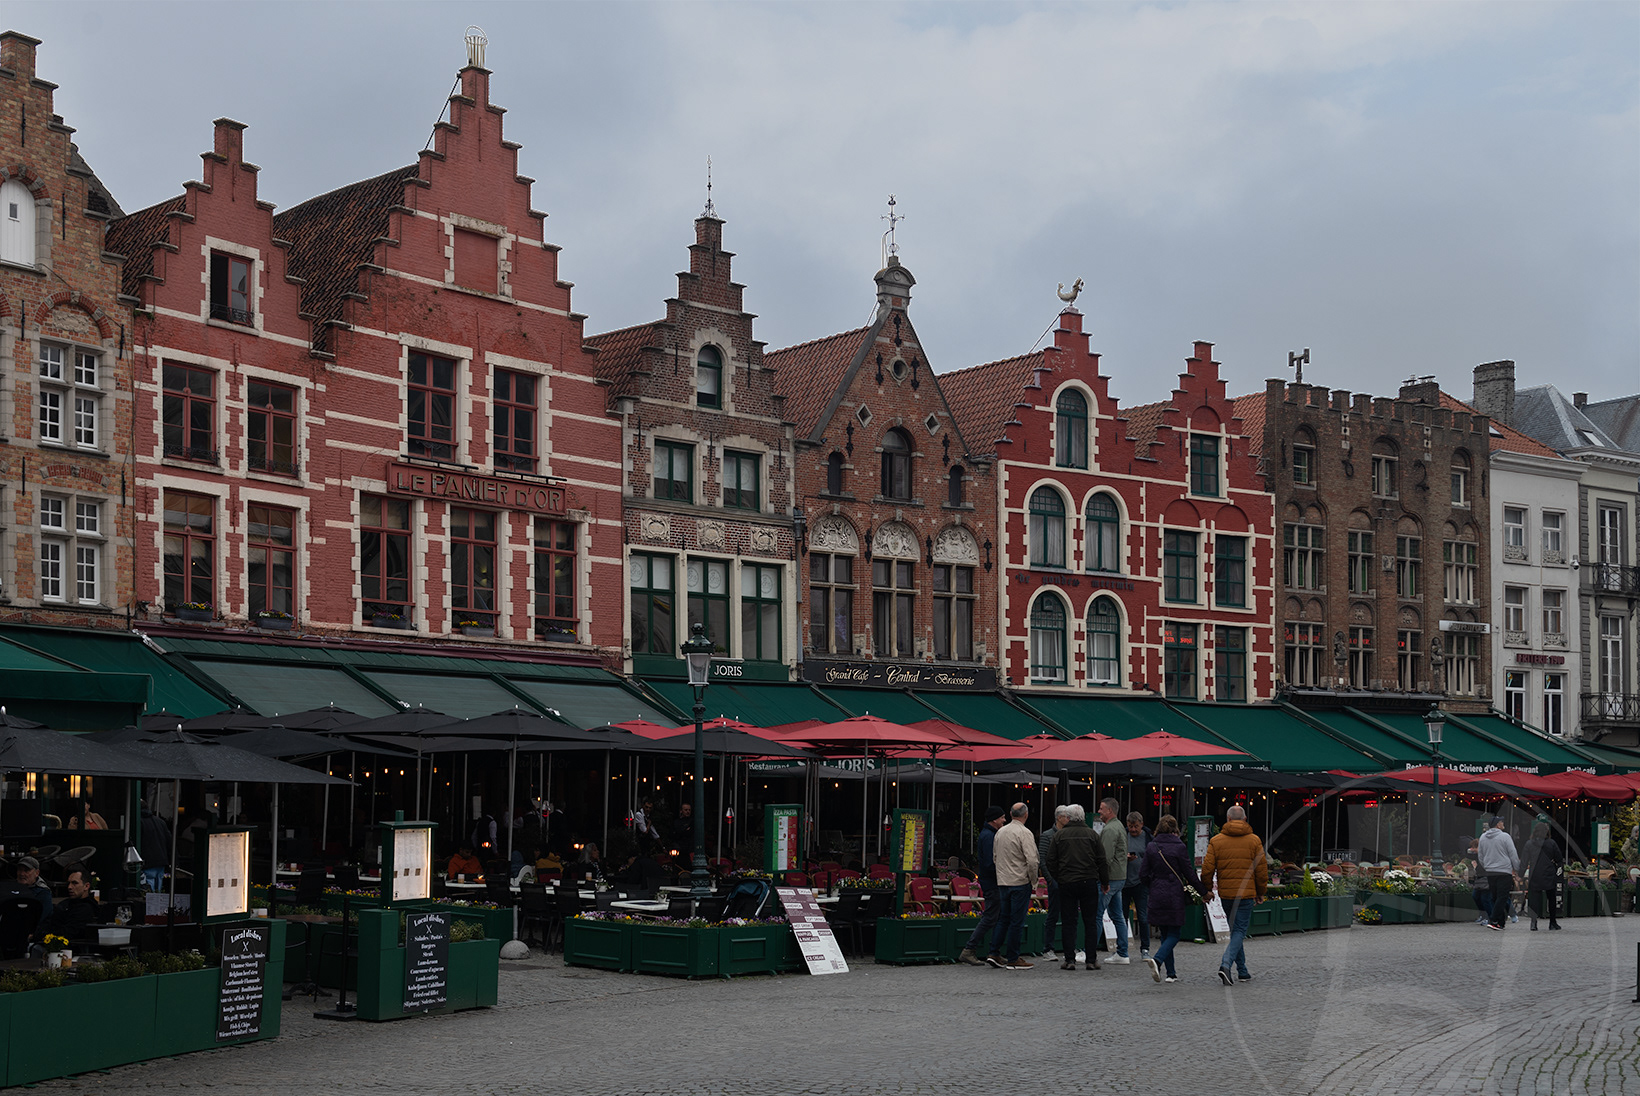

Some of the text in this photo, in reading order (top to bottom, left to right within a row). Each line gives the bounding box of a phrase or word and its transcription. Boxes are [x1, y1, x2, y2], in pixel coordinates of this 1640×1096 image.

[398, 473, 425, 491] LE
[432, 473, 508, 504] PANIER
[714, 666, 742, 676] JORIS
[886, 665, 919, 684] Central
[414, 914, 444, 927] Local dishes
[231, 929, 262, 943] Local dishes
